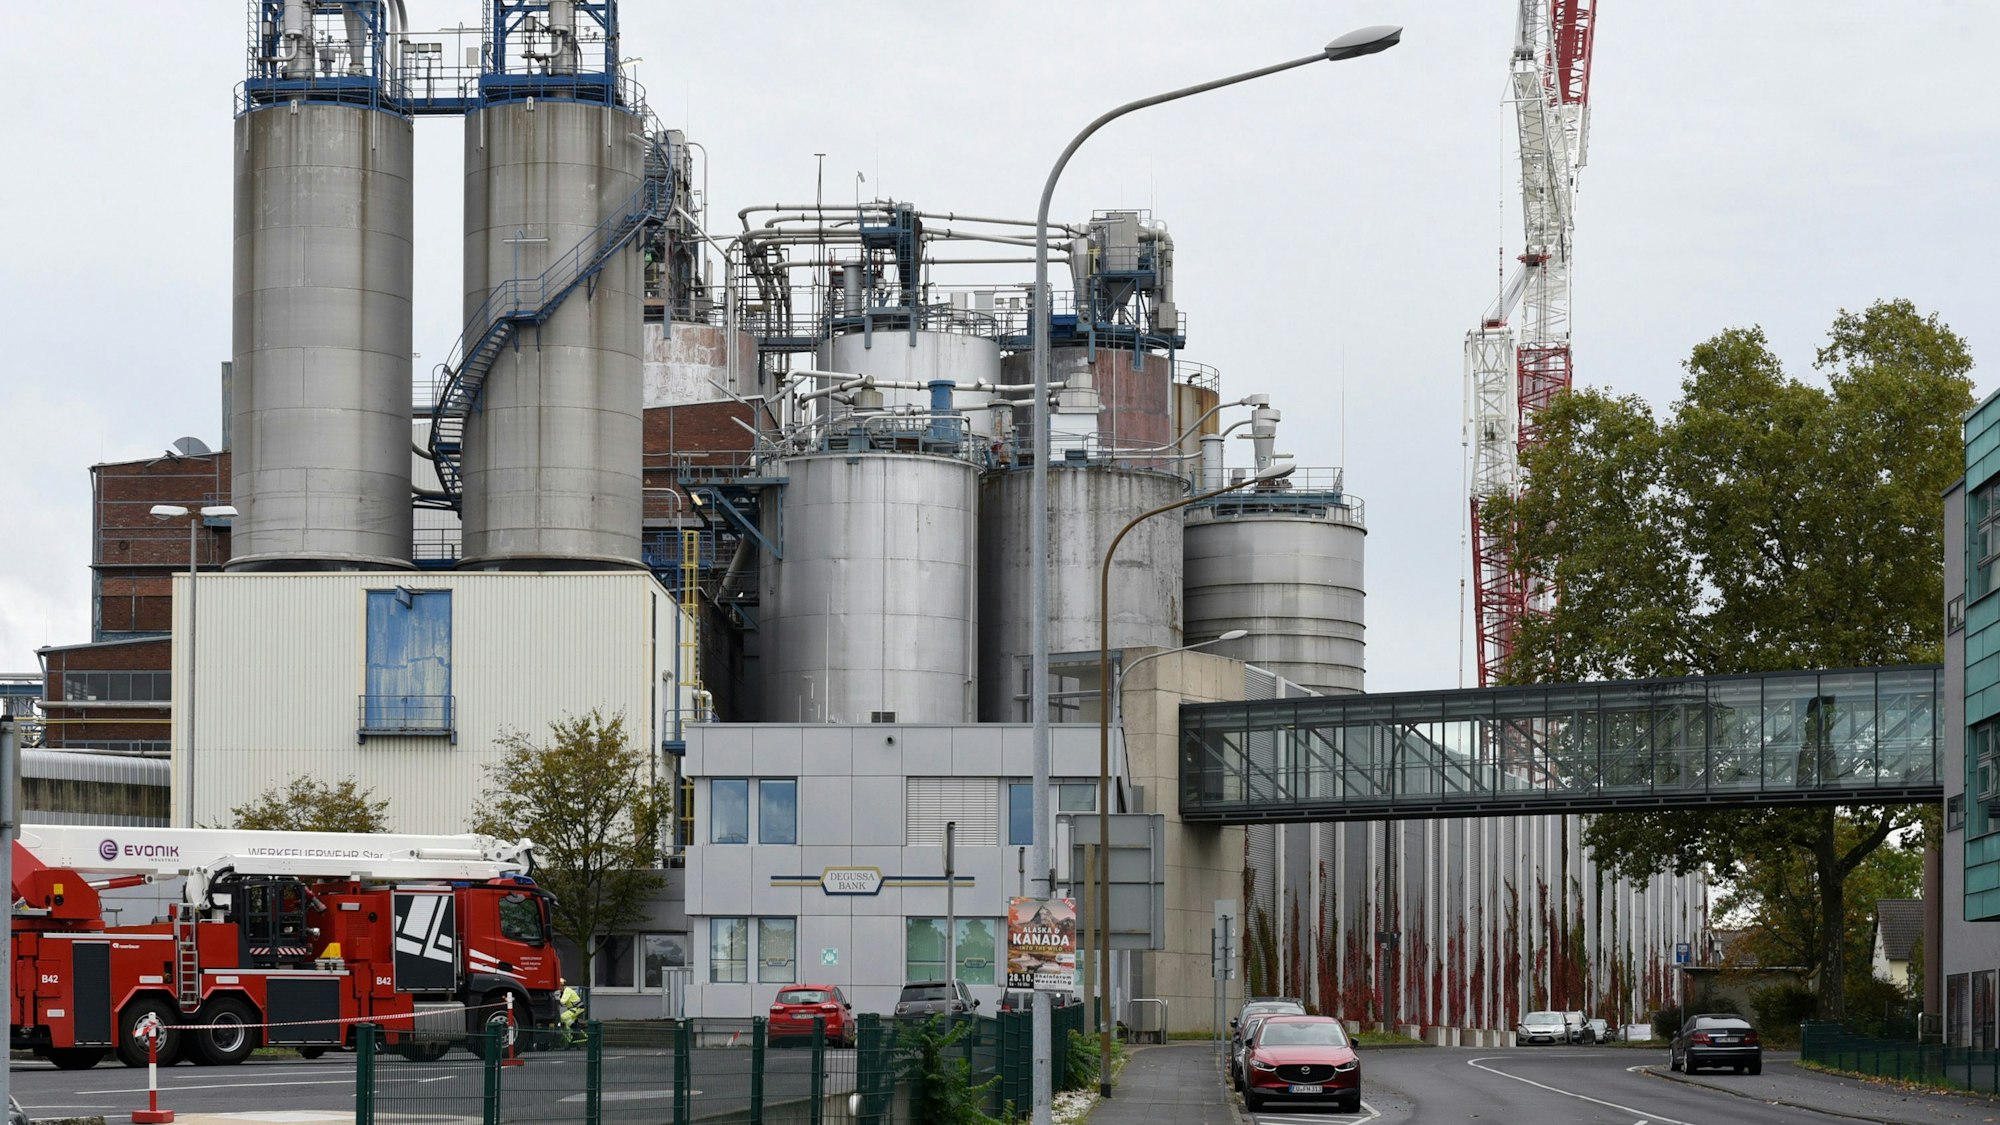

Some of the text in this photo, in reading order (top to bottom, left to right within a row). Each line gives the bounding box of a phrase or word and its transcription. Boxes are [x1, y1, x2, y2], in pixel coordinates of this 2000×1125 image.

[124, 845, 179, 857] EVONIK
[830, 872, 875, 881] DEGUSSA
[838, 881, 866, 890] BANK
[1023, 926, 1052, 934] ALASKA
[1013, 933, 1070, 946] KANADA
[41, 974, 59, 984] B42
[376, 976, 391, 985] B42
[1009, 973, 1034, 982] 28.10.
